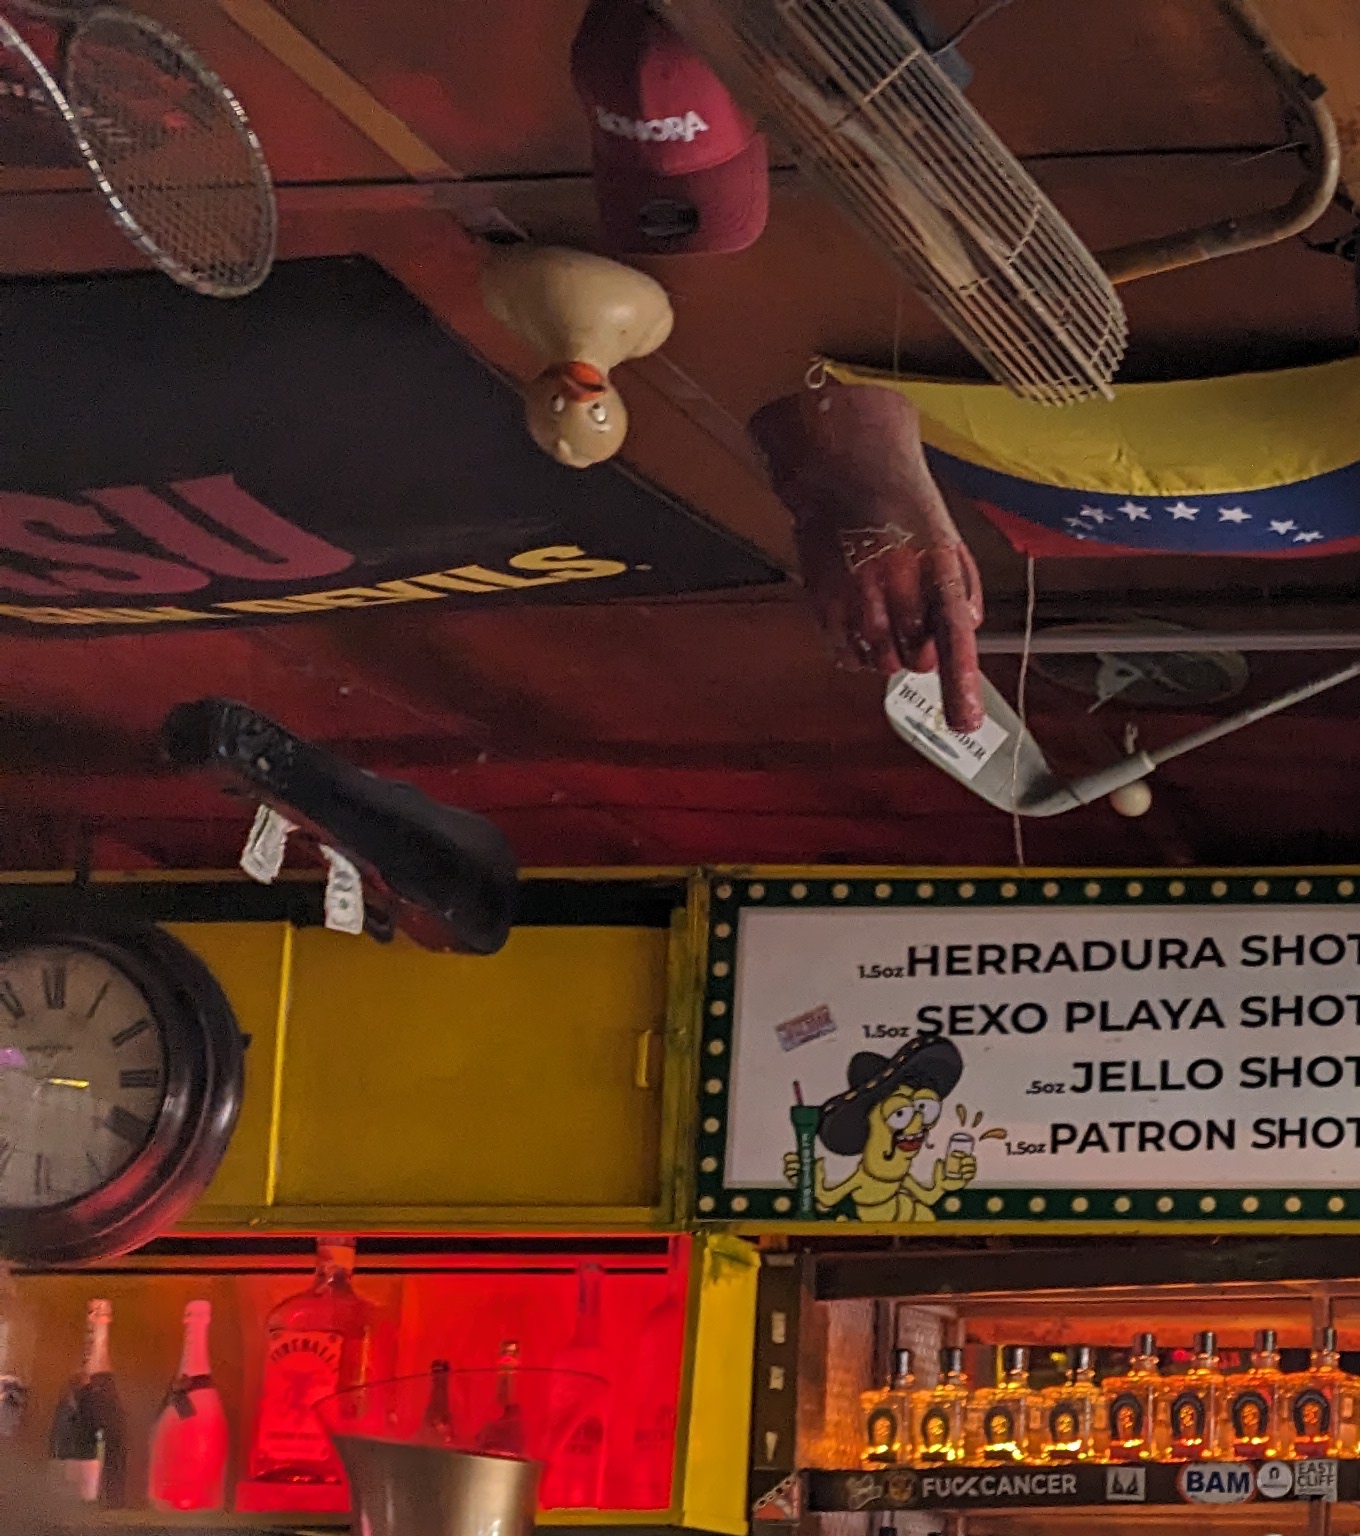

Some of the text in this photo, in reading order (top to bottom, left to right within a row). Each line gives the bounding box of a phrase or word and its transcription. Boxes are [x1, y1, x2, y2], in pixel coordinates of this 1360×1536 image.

[857, 962, 906, 982] 1.5oz
[905, 936, 1228, 978] HERRADURA
[861, 1022, 911, 1042] 1.5oz
[915, 1001, 1050, 1040] SEXO
[1062, 997, 1228, 1036] PLAYA
[1024, 1079, 1067, 1097] .5oz
[1068, 1056, 1226, 1097] JELLO
[1003, 1139, 1047, 1157] 1.5oz
[1049, 1118, 1238, 1157] PATRON
[1185, 1469, 1250, 1495] BAM
[1298, 1461, 1335, 1476] EAST
[1298, 1474, 1336, 1487] CLIFF
